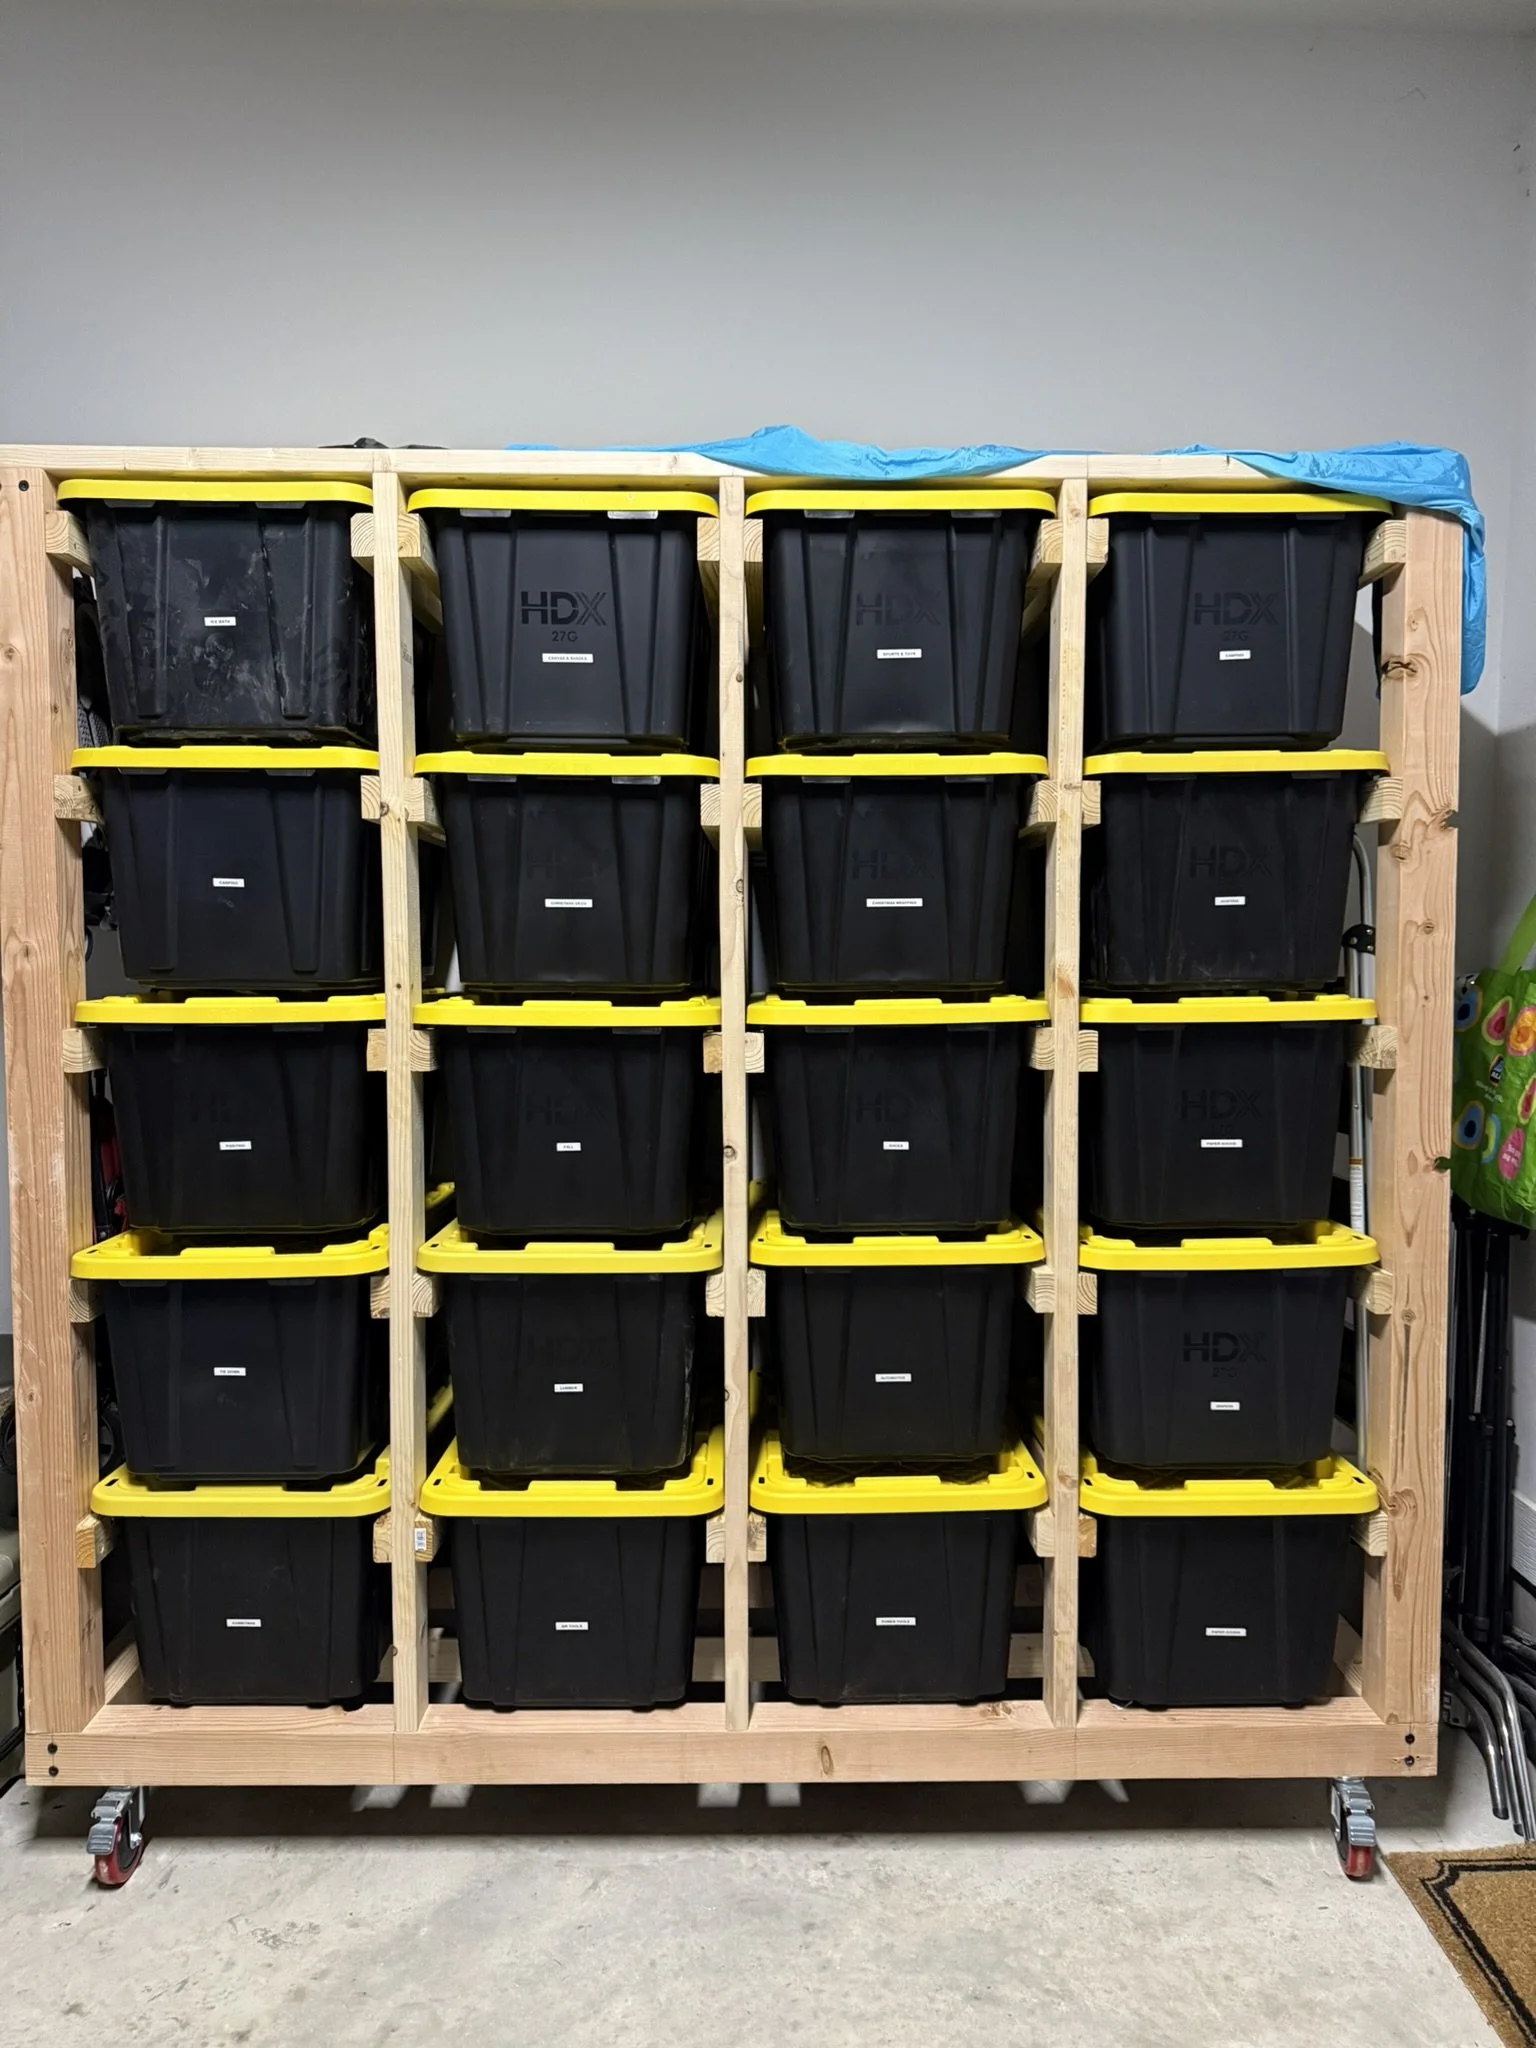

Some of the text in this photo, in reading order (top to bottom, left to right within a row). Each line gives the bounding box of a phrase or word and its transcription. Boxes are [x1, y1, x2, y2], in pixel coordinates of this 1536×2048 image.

[521, 591, 607, 626] HDX
[855, 592, 941, 626] HDX
[1194, 592, 1278, 626] HDX
[551, 630, 578, 642] 27G
[1223, 630, 1249, 642] 27G
[1189, 845, 1271, 879] HDX
[1181, 1088, 1262, 1120] HDX
[1183, 1331, 1266, 1363] HDX
